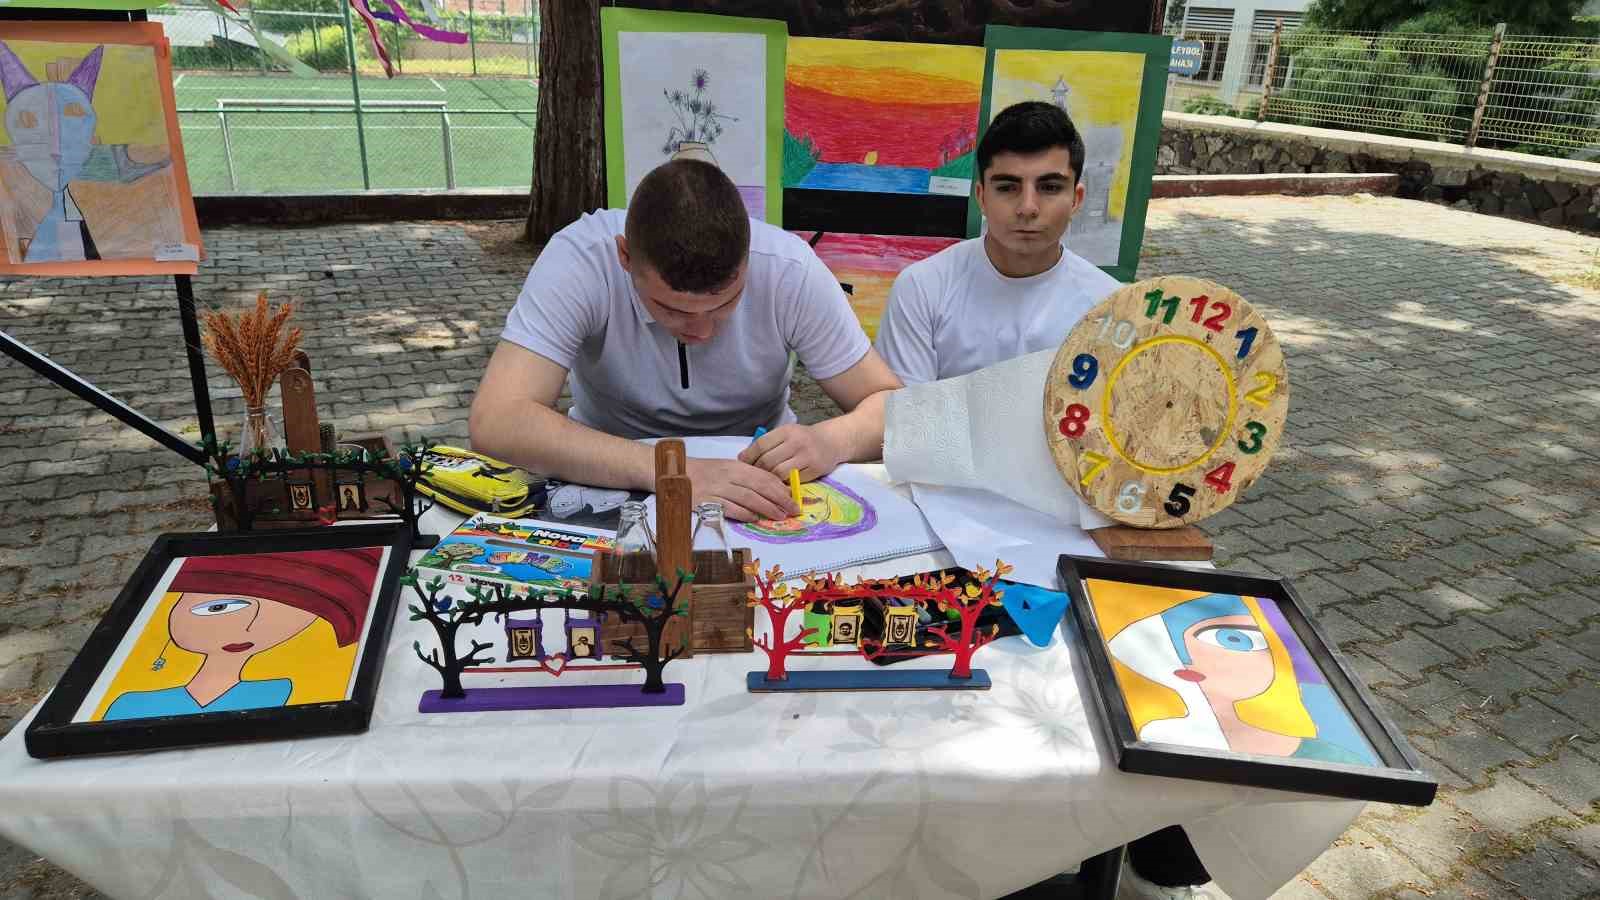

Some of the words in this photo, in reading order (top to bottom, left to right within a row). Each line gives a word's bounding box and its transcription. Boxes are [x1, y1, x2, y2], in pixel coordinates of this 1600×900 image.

[1144, 288, 1181, 324] 11
[1190, 295, 1232, 333] 12
[1099, 314, 1137, 350] 10
[1235, 327, 1258, 360] 1
[1068, 353, 1099, 390] 9
[1244, 371, 1277, 409] 2
[1059, 403, 1090, 439] 8
[1238, 421, 1267, 454] 3
[1081, 451, 1111, 486] 7
[1204, 461, 1236, 494] 4
[1117, 480, 1148, 513] 6
[1164, 483, 1196, 518] 5
